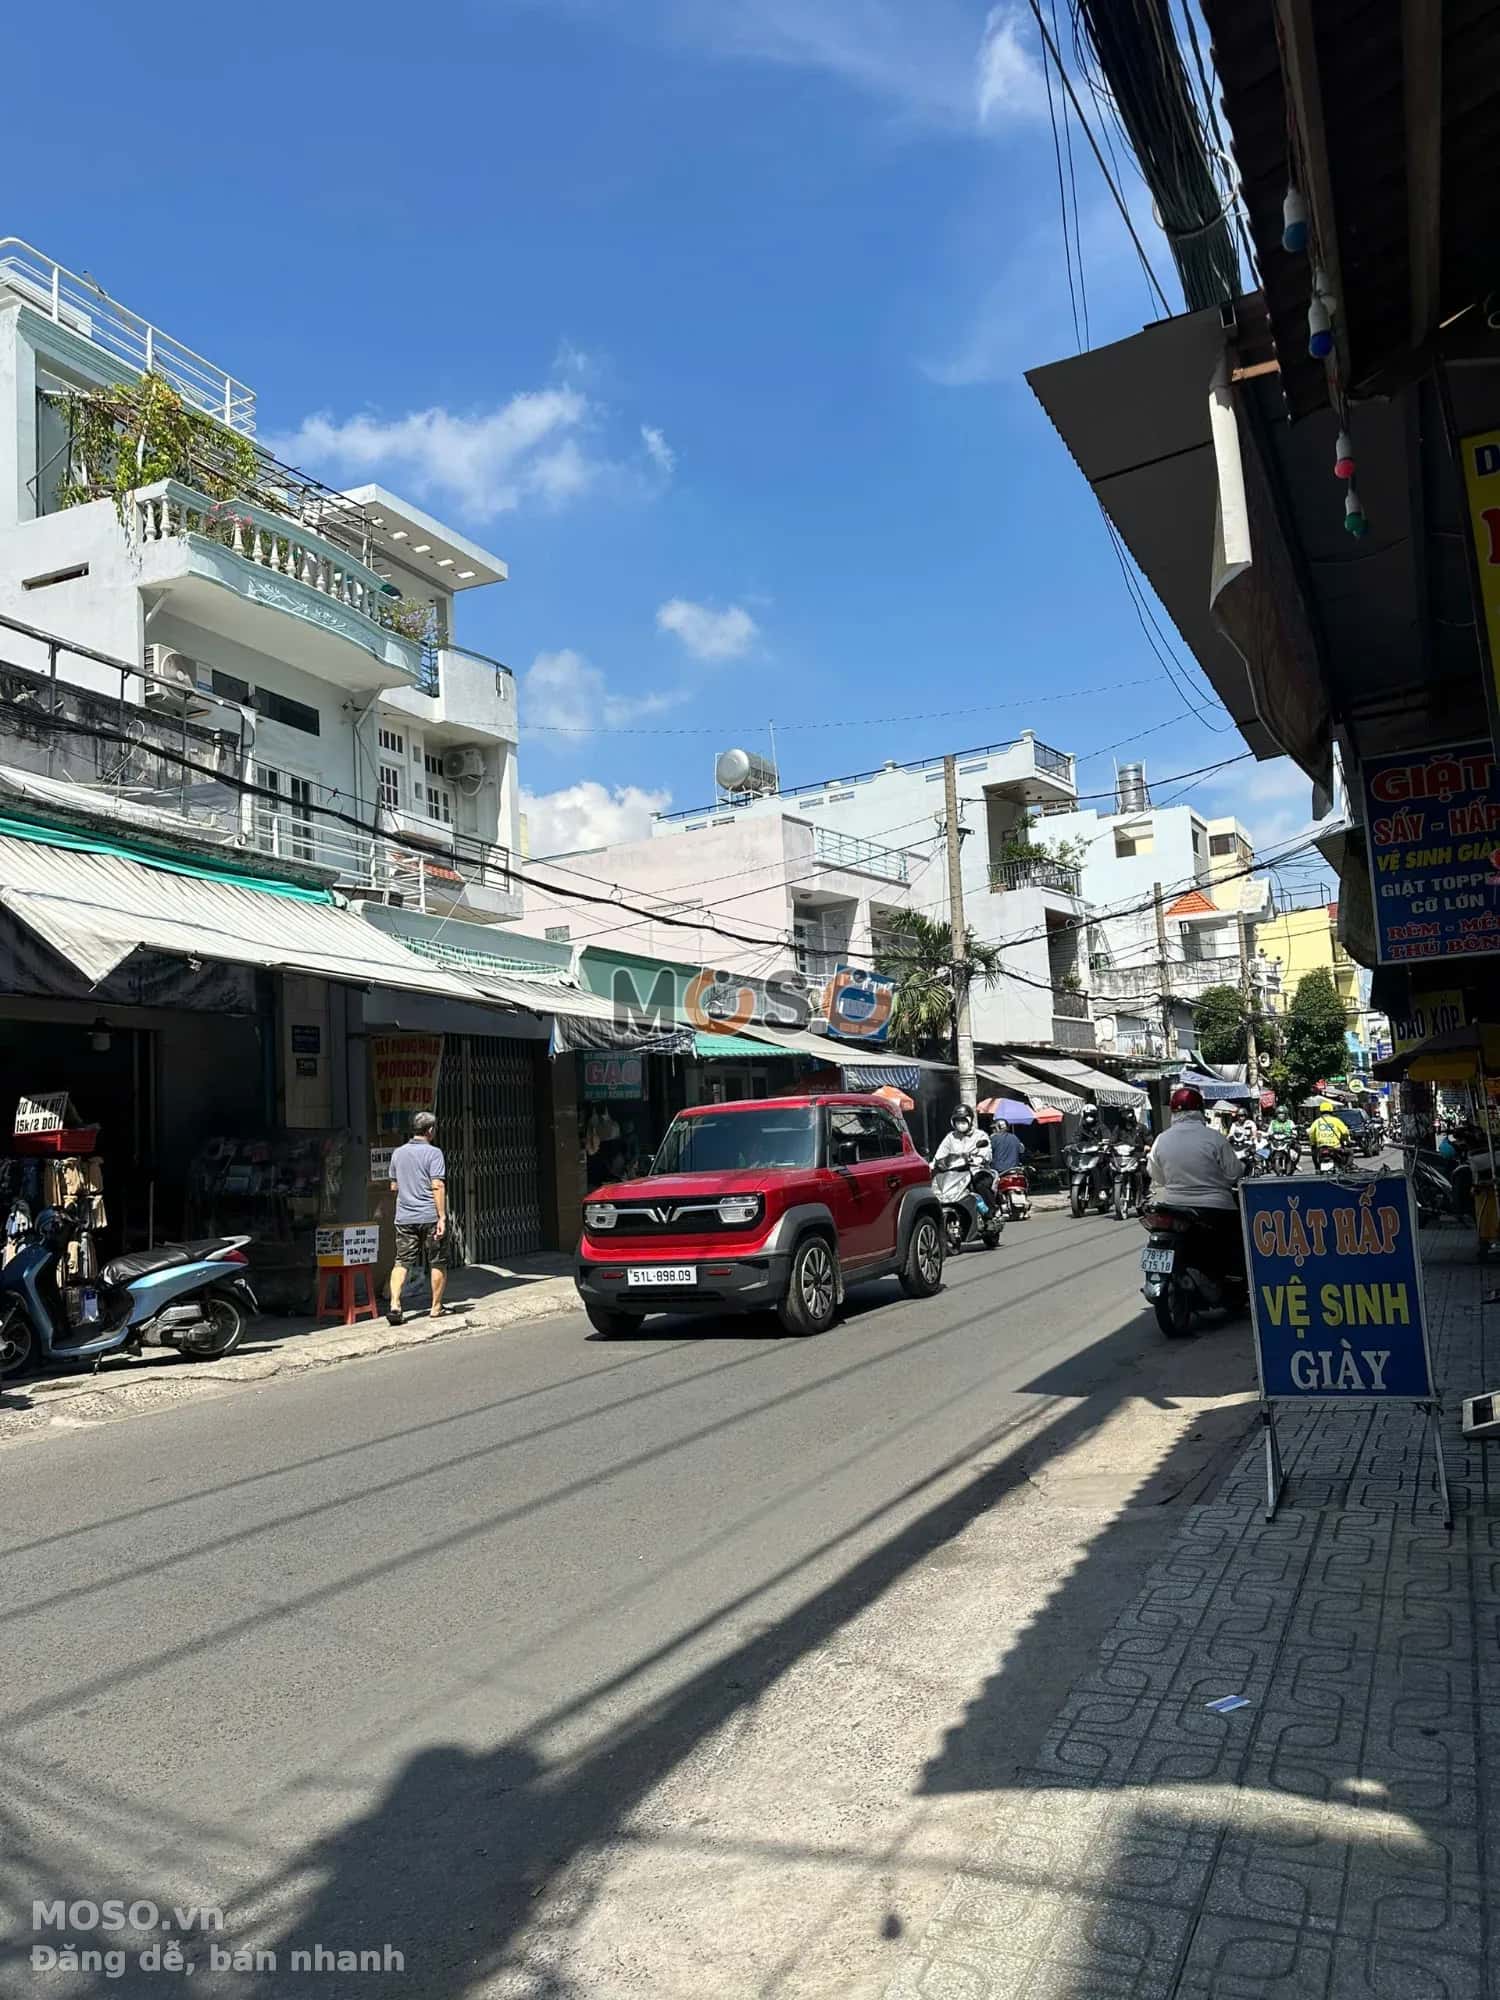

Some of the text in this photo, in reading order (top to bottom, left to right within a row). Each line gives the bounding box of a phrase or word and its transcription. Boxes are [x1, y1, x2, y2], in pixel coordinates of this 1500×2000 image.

[1370, 753, 1496, 802] GIẶT
[1373, 806, 1425, 846] SẤY
[1448, 796, 1500, 837] HẤP
[1377, 848, 1400, 876] VỆ
[1405, 846, 1452, 869] SINH
[1387, 920, 1441, 942] RÈM
[585, 1060, 641, 1089] GẠO
[1253, 1183, 1400, 1267] GIẶT HẤP
[633, 1269, 692, 1282] 51L-898.09
[1261, 1275, 1411, 1338] VỆ SINH
[1290, 1338, 1391, 1390] GIÀY
